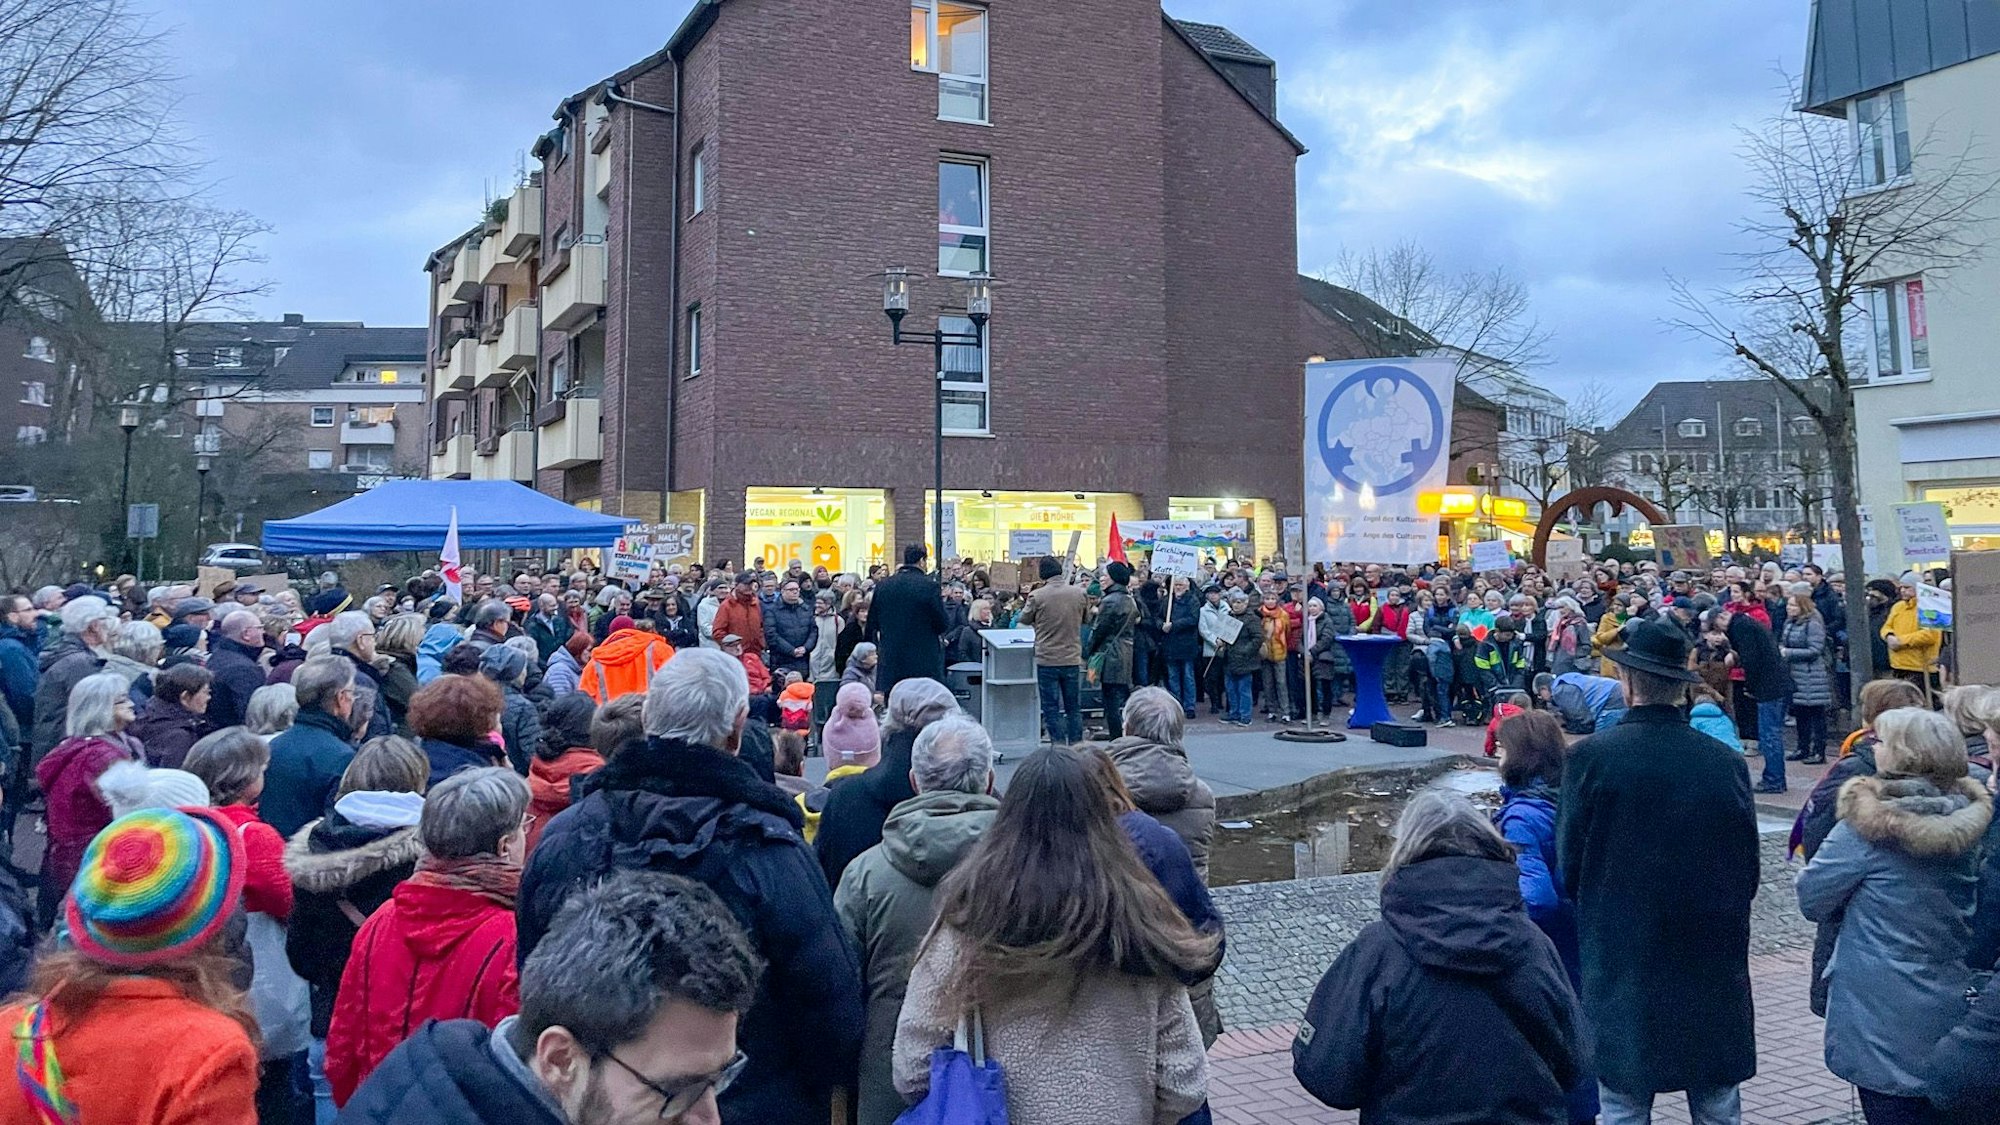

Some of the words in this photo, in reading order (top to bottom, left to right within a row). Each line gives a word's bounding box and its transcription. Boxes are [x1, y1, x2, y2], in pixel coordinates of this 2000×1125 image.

[779, 508, 816, 518] REGIONAL
[1030, 512, 1041, 522] DIE
[1050, 511, 1075, 522] MÖHRE
